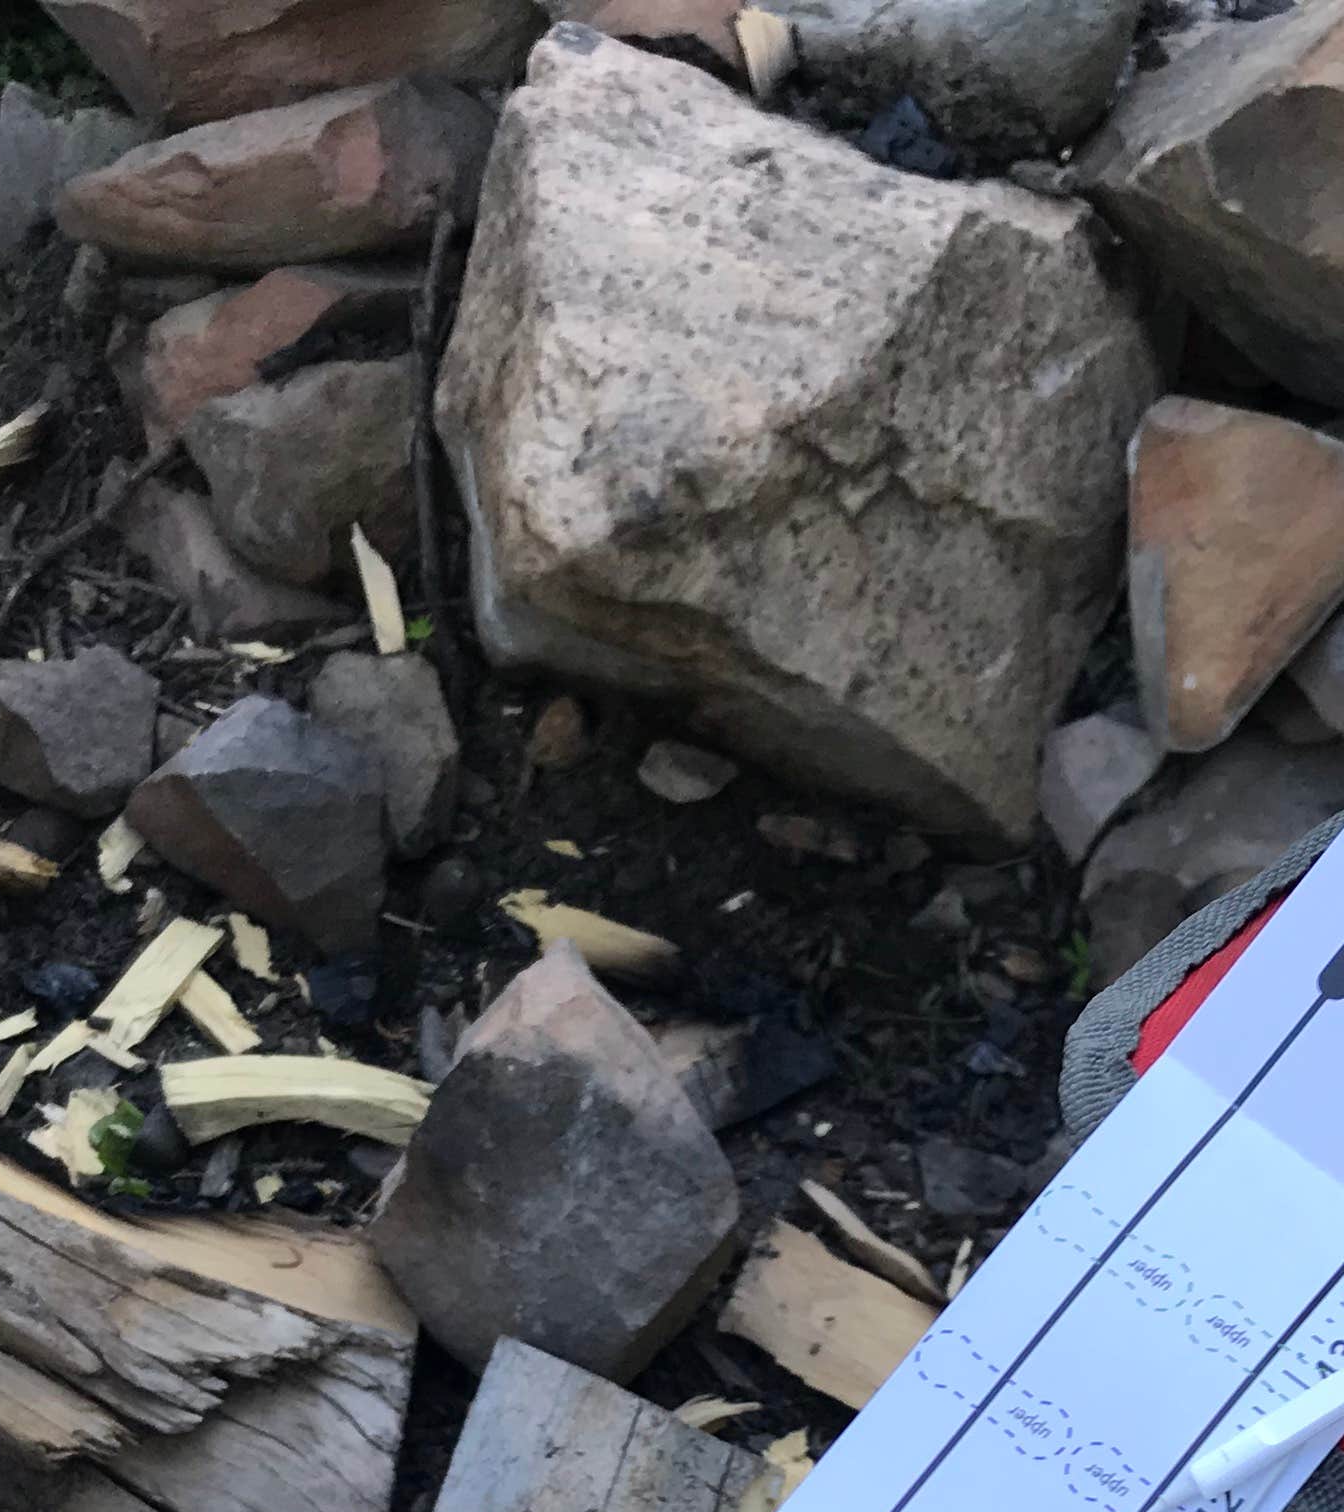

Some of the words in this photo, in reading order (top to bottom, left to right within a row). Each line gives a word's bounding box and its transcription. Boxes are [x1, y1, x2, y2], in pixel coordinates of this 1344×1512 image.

[1127, 1260, 1172, 1291] upper
[1205, 1316, 1250, 1348] upper
[1006, 1407, 1052, 1438] upper
[1084, 1464, 1130, 1497] upper
